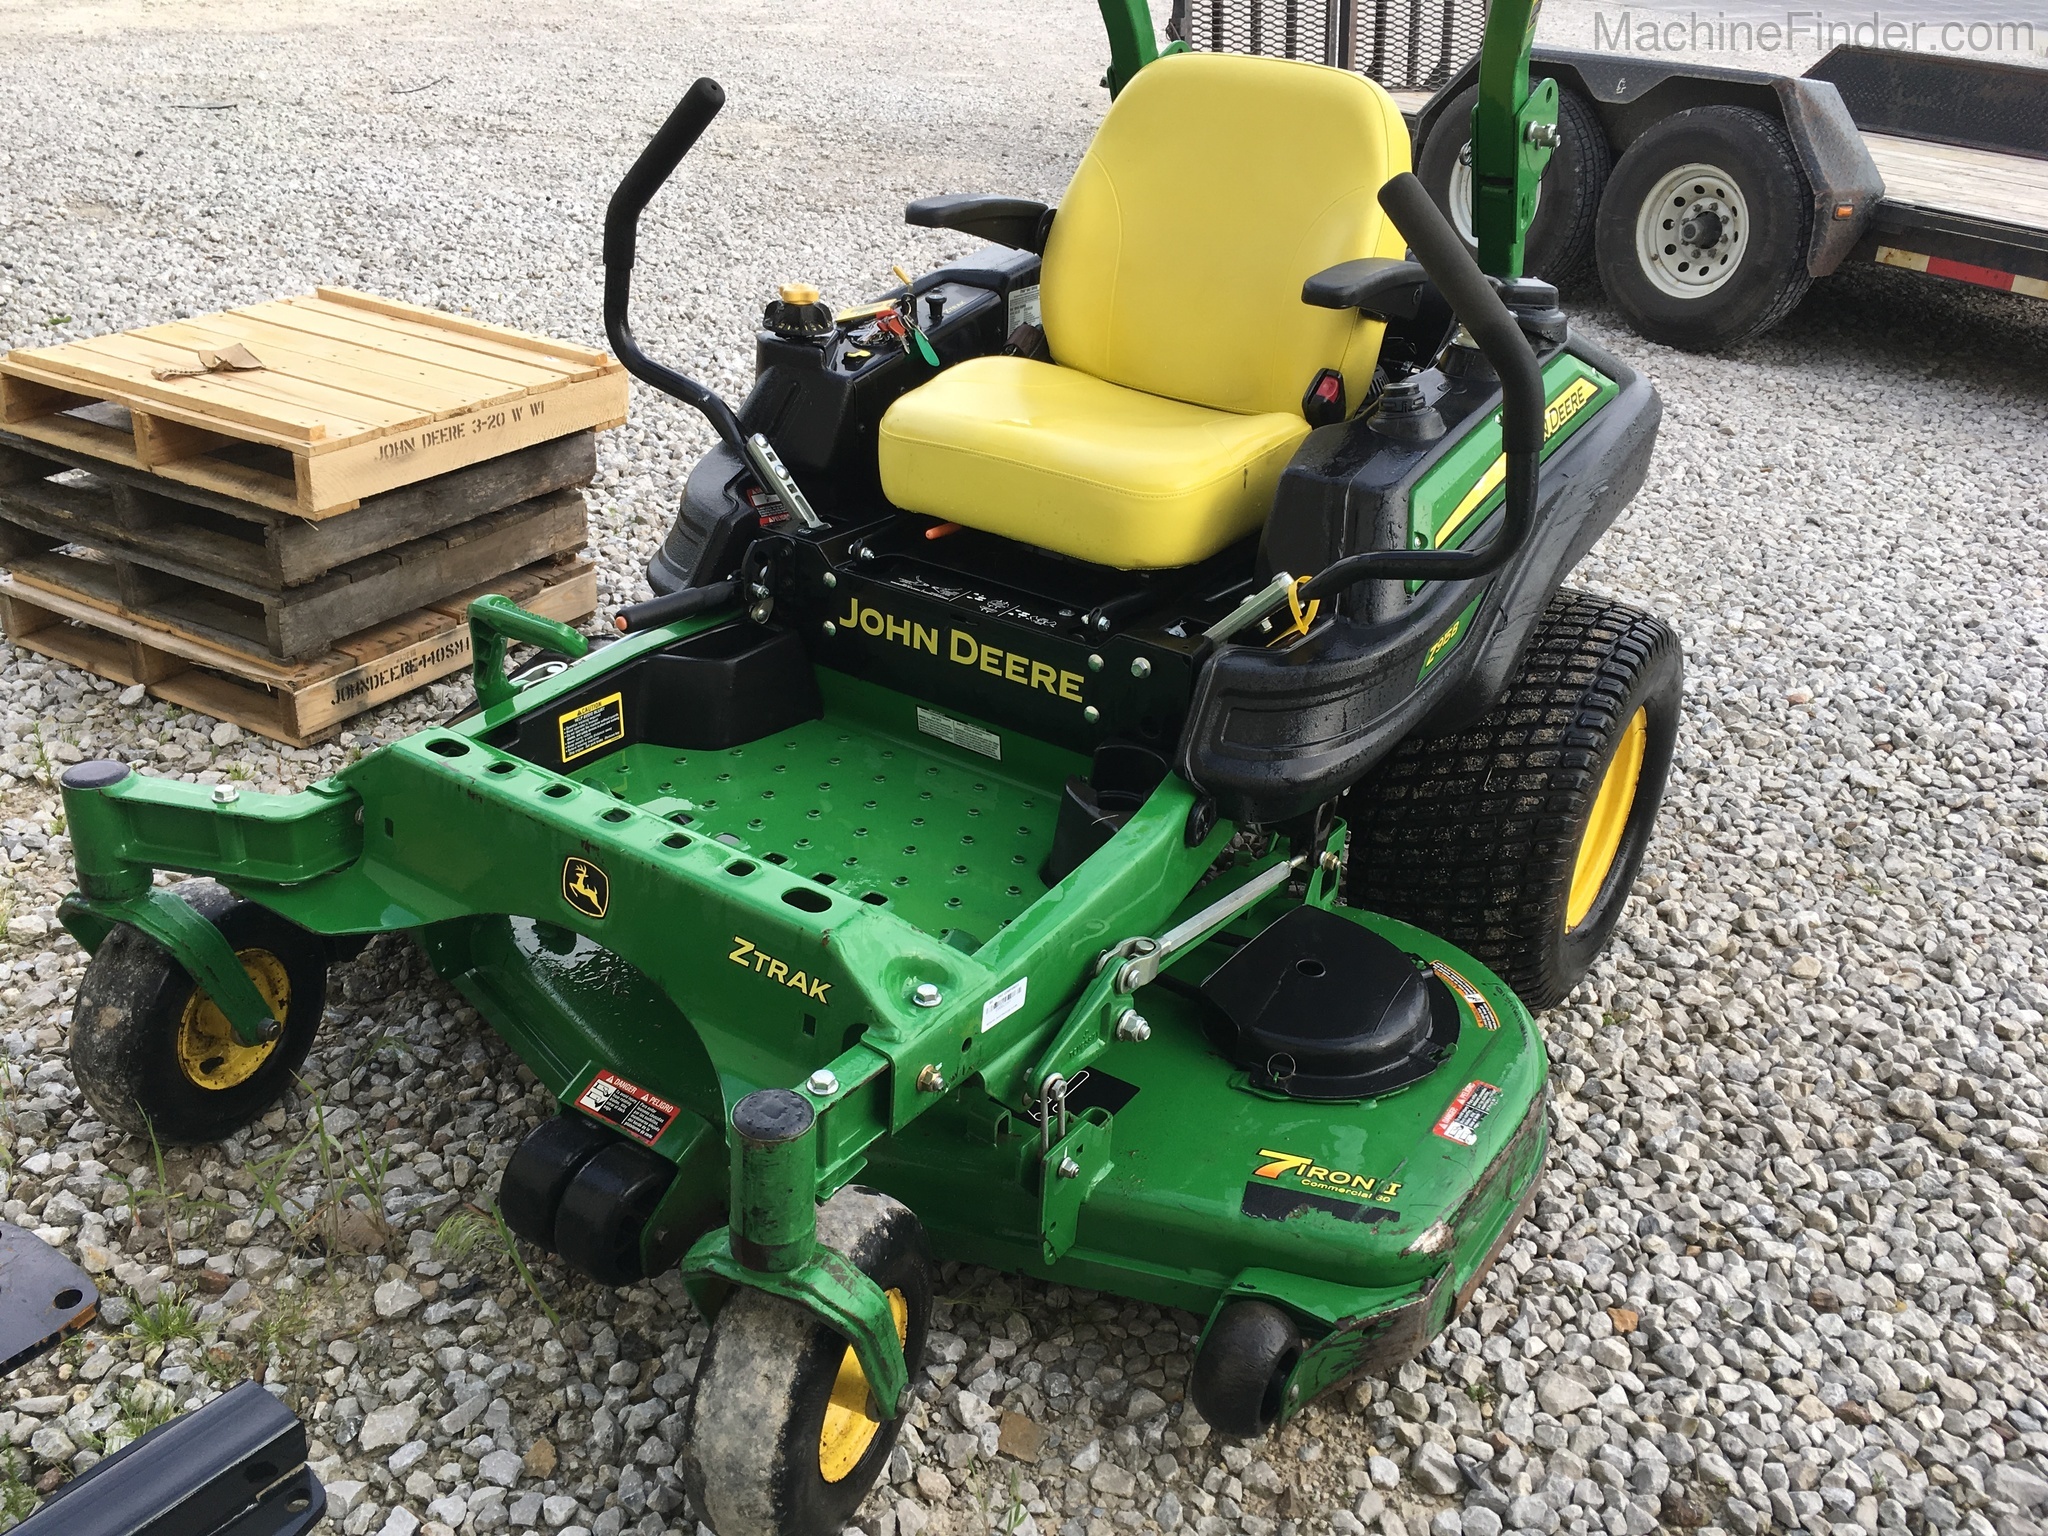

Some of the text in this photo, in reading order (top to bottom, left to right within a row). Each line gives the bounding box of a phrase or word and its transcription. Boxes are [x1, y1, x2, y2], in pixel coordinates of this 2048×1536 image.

[1549, 386, 1585, 430] DEERE
[374, 437, 415, 461] JOHN
[422, 422, 465, 448] DEERE
[471, 412, 505, 434] 3-20
[839, 597, 1085, 703] JOHN DEERE
[728, 935, 833, 1005] ZTRAK
[613, 1077, 638, 1095] DANGER
[648, 1095, 674, 1113] PELIGRO
[1301, 1178, 1372, 1199] Commercial
